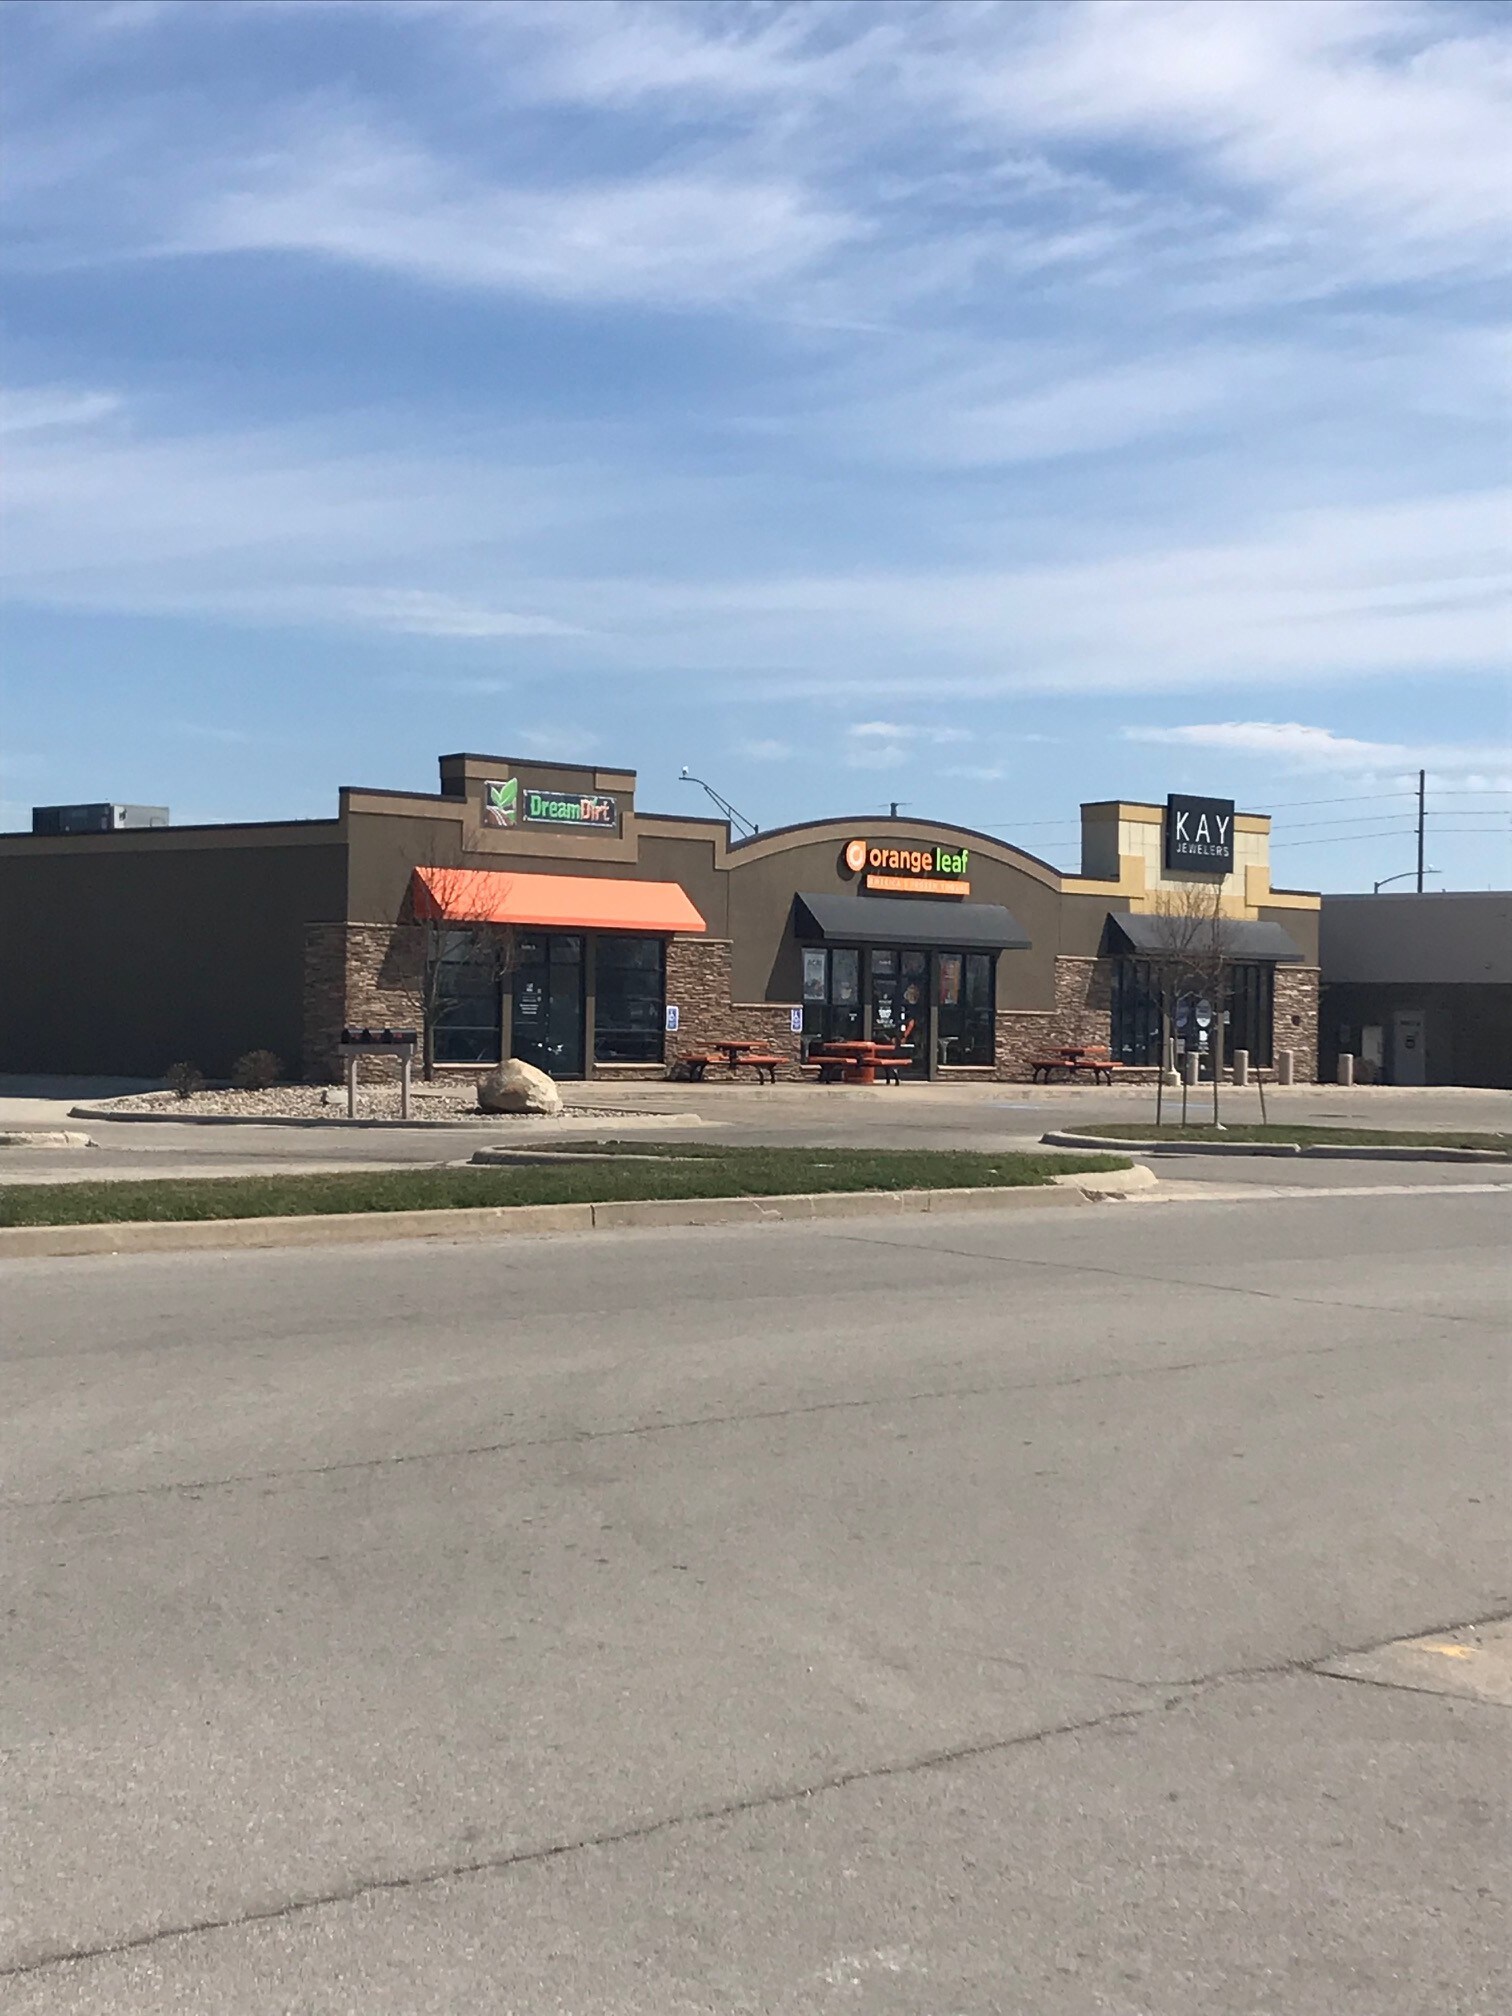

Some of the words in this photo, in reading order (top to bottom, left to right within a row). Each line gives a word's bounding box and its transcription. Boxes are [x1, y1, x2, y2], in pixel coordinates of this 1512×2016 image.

[530, 795, 610, 821] DreamDirt
[1176, 811, 1230, 844] KAY
[869, 848, 933, 873] orange
[936, 847, 969, 874] leaf
[1176, 842, 1230, 857] JEWELERS
